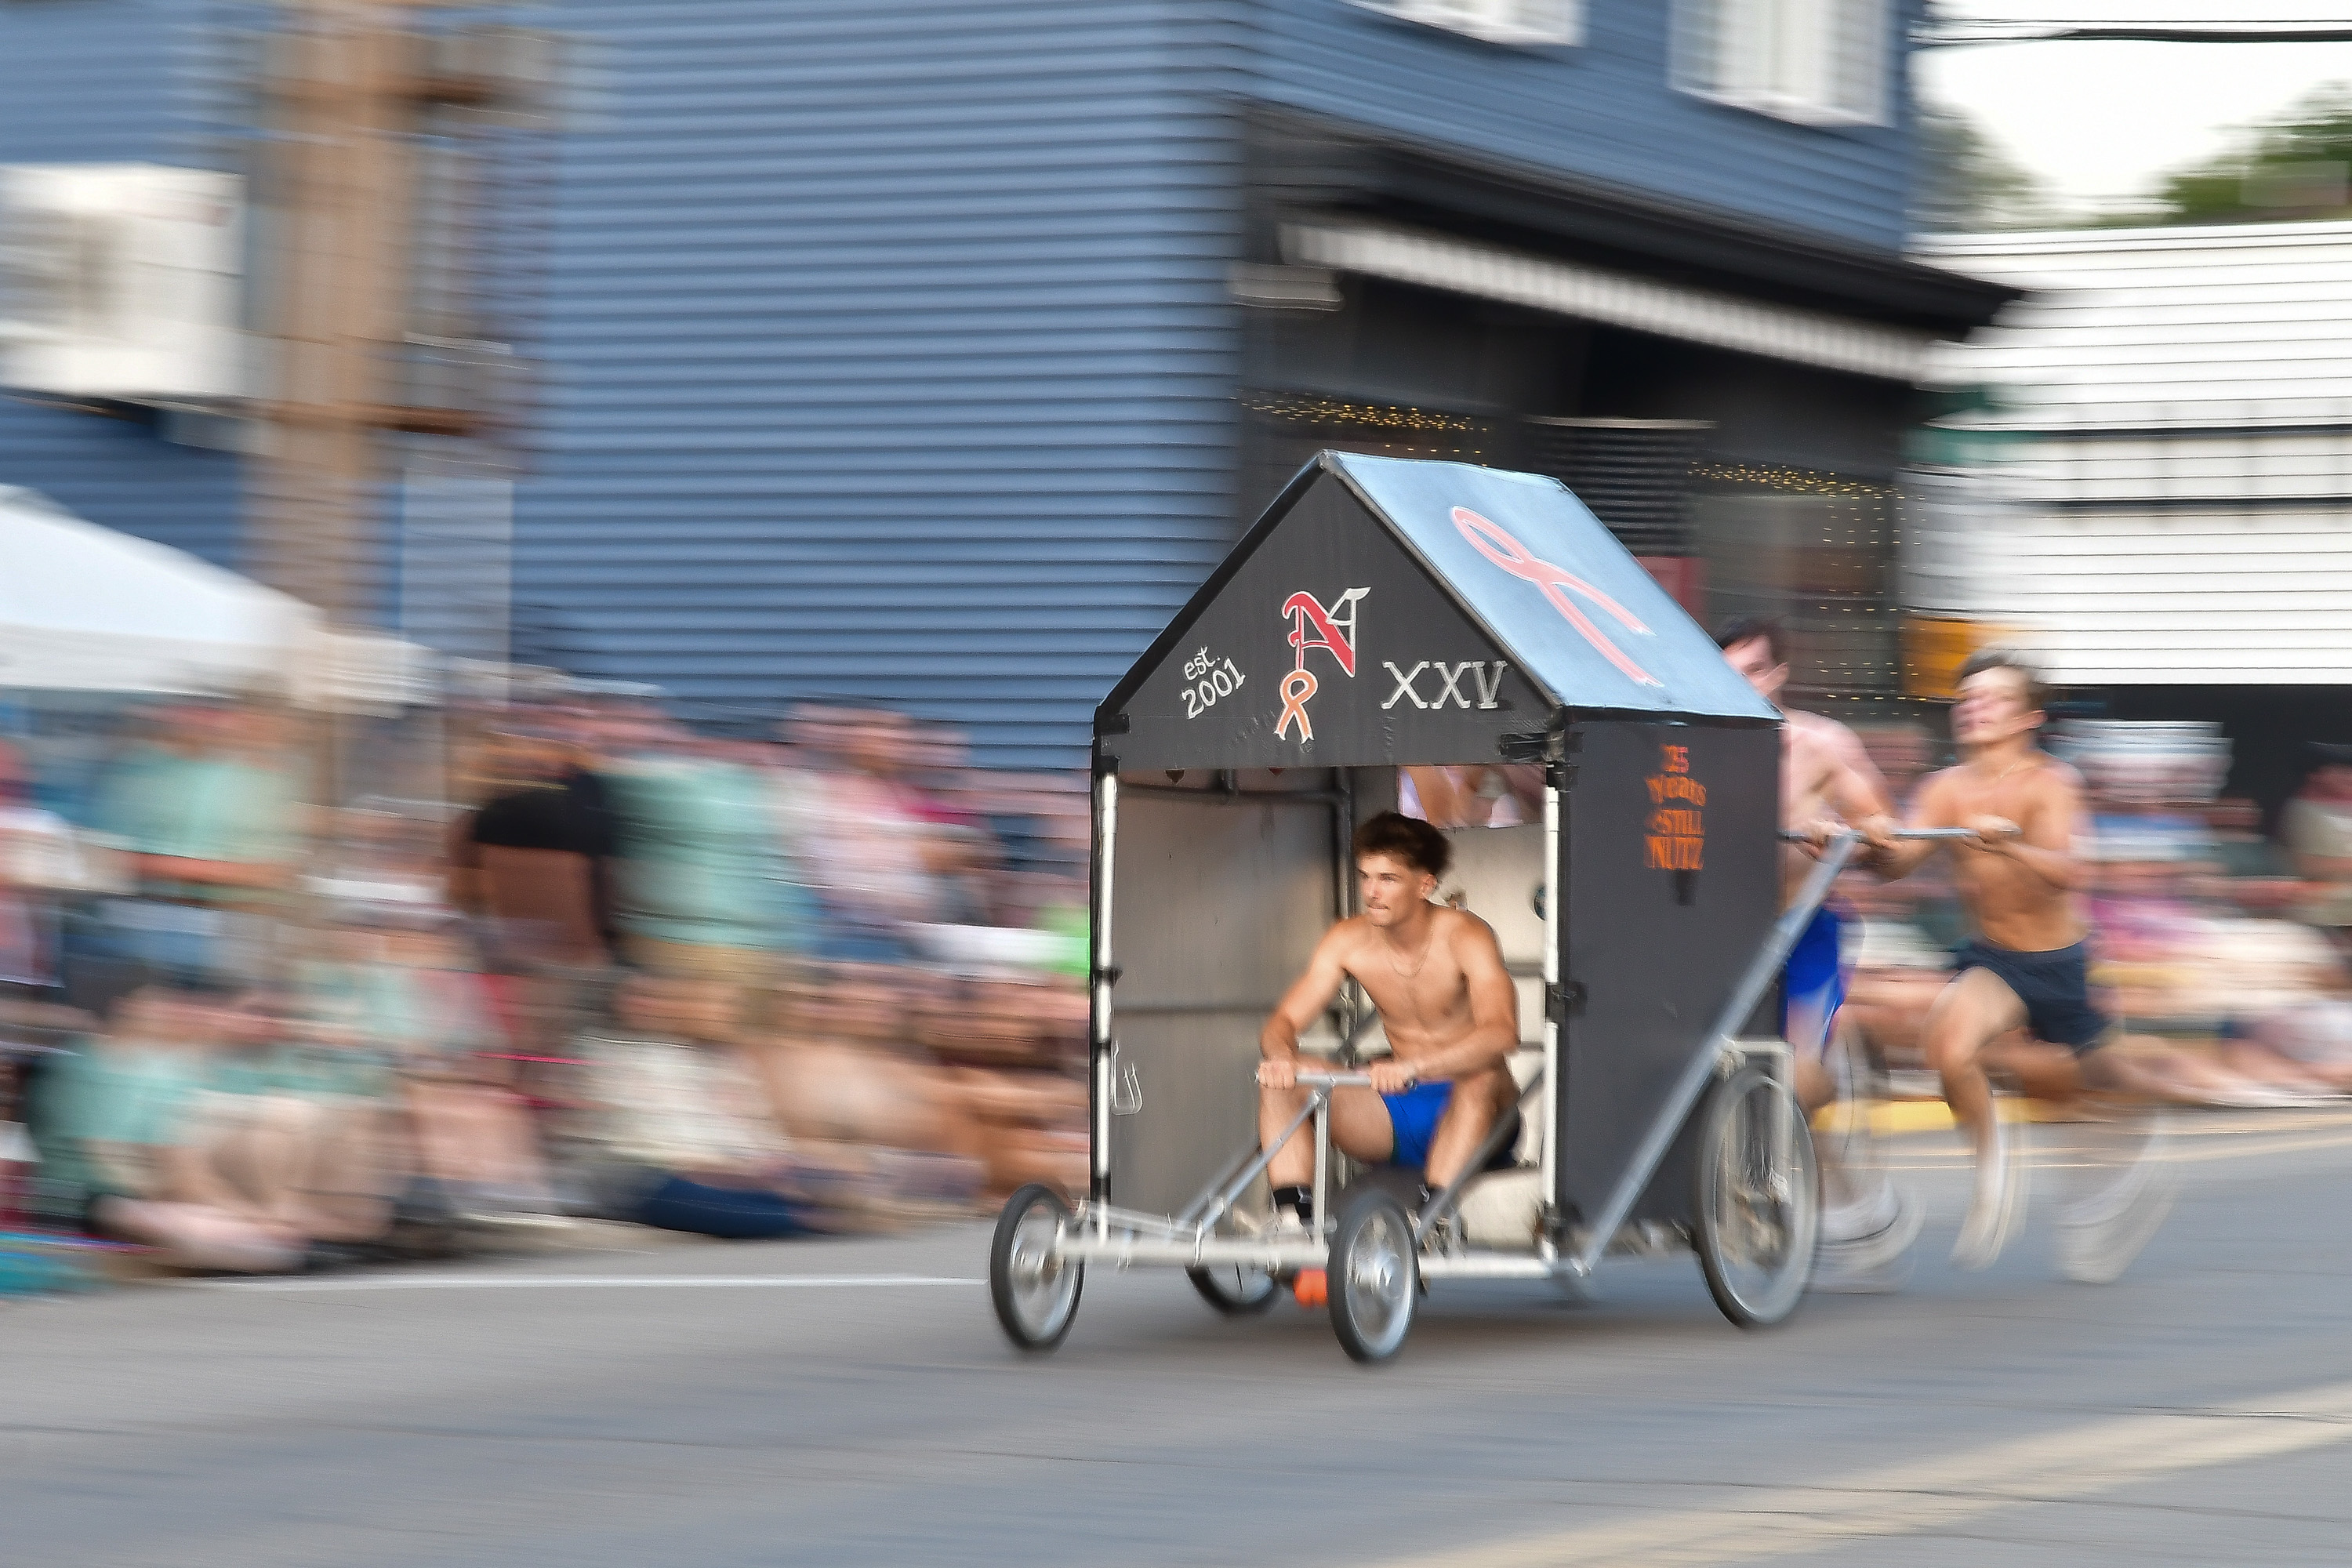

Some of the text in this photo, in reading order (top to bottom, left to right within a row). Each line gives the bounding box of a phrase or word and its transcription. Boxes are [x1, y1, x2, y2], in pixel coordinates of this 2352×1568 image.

[1184, 645, 1220, 681] est.
[1181, 657, 1246, 719] 2001
[1381, 660, 1508, 709] XXV
[1646, 809, 1704, 835] STILL
[1644, 835, 1704, 870] NUTZ
